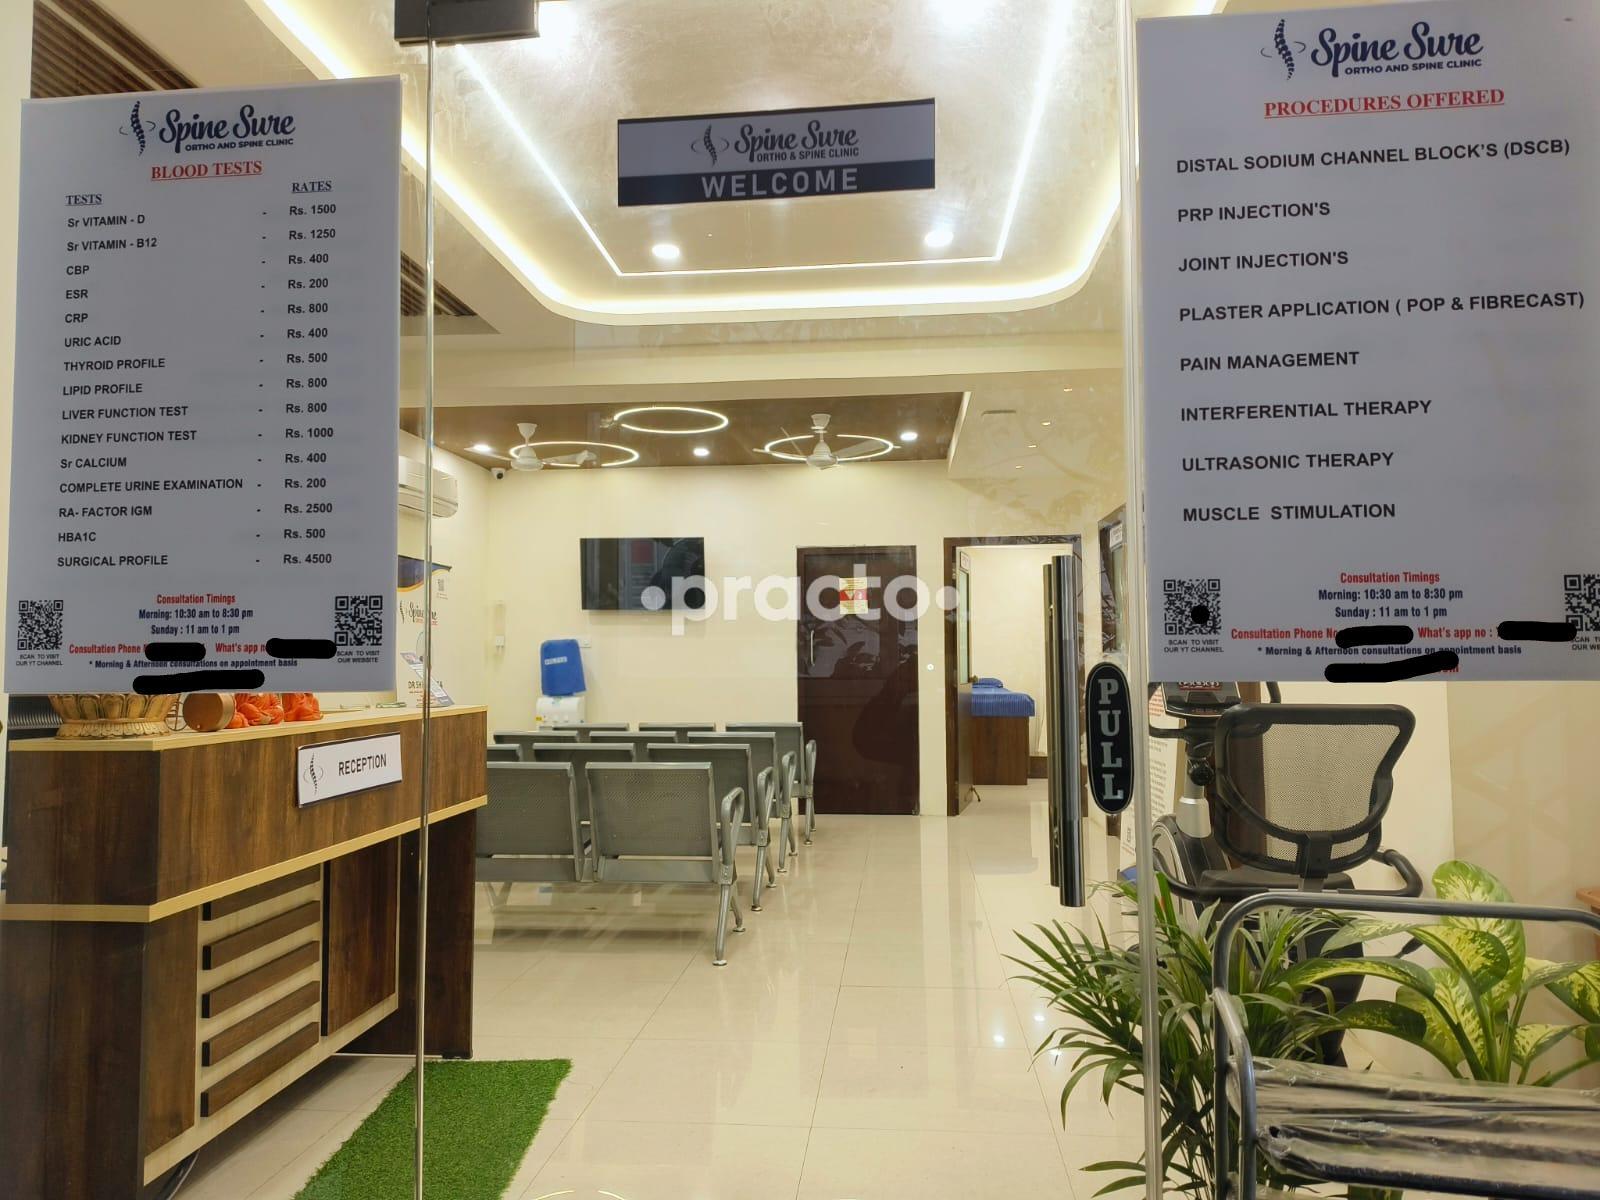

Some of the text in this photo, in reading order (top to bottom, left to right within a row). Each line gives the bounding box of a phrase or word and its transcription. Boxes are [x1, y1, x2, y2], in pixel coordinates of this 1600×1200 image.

[1311, 21, 1484, 77] Spine Sure
[1344, 58, 1482, 75] ORTHO AND SPINE CLINIC
[1264, 88, 1504, 117] PROCEDURES OFFERED
[160, 104, 296, 153] Spine Sure
[185, 138, 294, 152] ORTHO AND SPINE CLINIC
[734, 119, 859, 162] Spine Sure
[756, 147, 860, 163] ORTHO & SPINE CLINIC
[1176, 157, 1240, 174] DISTAL
[1243, 152, 1315, 170] SODIUM
[1320, 148, 1410, 166] CHANNEL
[1503, 138, 1570, 160] (DSCB)
[151, 160, 263, 181] BLOOD TESTS
[291, 180, 333, 194] RATES
[701, 167, 859, 199] WELCOME
[65, 193, 103, 206] TESTS
[289, 203, 337, 216] Rs. 1500
[1177, 201, 1331, 223] PRP INJECTION'S
[67, 217, 80, 228] Sr
[82, 215, 128, 228] VITAMIN
[136, 214, 146, 225] D
[288, 227, 336, 241] Rs. 1250
[66, 241, 80, 252] Sr
[81, 239, 127, 251] VITAMIN
[136, 237, 158, 249] B12
[288, 253, 329, 265] Rs. 400
[1177, 250, 1349, 273] JOINT INJECTION'S
[65, 264, 90, 276] CBP
[287, 277, 329, 290] Rs. 200
[65, 288, 89, 300] ESR
[287, 302, 329, 315] Rs. 800
[1179, 304, 1264, 322] PLASTER
[1267, 299, 1390, 318] APPLICATION
[1406, 297, 1446, 313] POP
[1450, 296, 1465, 311] &
[1469, 290, 1585, 311] FIBRECAST)
[64, 312, 89, 324] CRP
[286, 327, 329, 339] Rs. 400
[64, 335, 122, 348] URIC ACID
[63, 357, 166, 372] THYROID PROFILE
[286, 351, 328, 364] Rs. 500
[1180, 350, 1360, 372] PAIN MANAGEMENT
[62, 382, 143, 396] LIPID PROFILE
[286, 377, 328, 389] Rs. 800
[61, 405, 189, 421] LIVER FUNCTION TEST
[285, 402, 328, 414] Rs. 800
[1181, 399, 1432, 422] INTERFERENTIAL THERAPY
[60, 429, 198, 445] KIDNEY FUNCTION TEST
[285, 427, 334, 439] Rs. 1000
[60, 456, 127, 469] Sr CALCIUM
[284, 452, 327, 464] Rs. 400
[1182, 451, 1395, 472] ULTRASONIC THERAPY
[59, 478, 244, 494] COMPLETE URINE EXAMINATION
[284, 477, 327, 489] Rs. 200
[58, 505, 153, 518] RA- FACTOR IGM
[283, 502, 333, 514] Rs. 2500
[1183, 503, 1396, 522] MUSCLE STIMULATION
[57, 531, 97, 543] HBA1C
[283, 528, 326, 540] Rs. 500
[56, 554, 169, 568] SURGICAL PROFILE
[283, 553, 333, 565] Rs. 4500
[1339, 571, 1441, 586] Consultation Timings
[156, 593, 236, 606] Consultation Timings
[1318, 587, 1464, 603] Morning: 10:30 am to 8:30 pm
[138, 607, 254, 621] Morning: 10:30 am to 8:30 pm
[1334, 606, 1370, 620] Sunday
[1378, 605, 1390, 617] 11
[1393, 607, 1409, 618] am
[1410, 606, 1421, 618] to
[1423, 605, 1429, 617] 1
[1432, 607, 1448, 620] pm
[150, 624, 179, 637] Sunday
[185, 623, 195, 635] 11
[197, 625, 209, 635] am
[210, 624, 219, 635] to
[221, 623, 226, 634] 1
[227, 625, 240, 636] pm
[1231, 627, 1291, 640] Consultation
[1294, 627, 1324, 639] Phone
[1417, 626, 1487, 640] What's app no
[1096, 677, 1126, 802] PULL
[338, 753, 387, 777] RECEPTION
